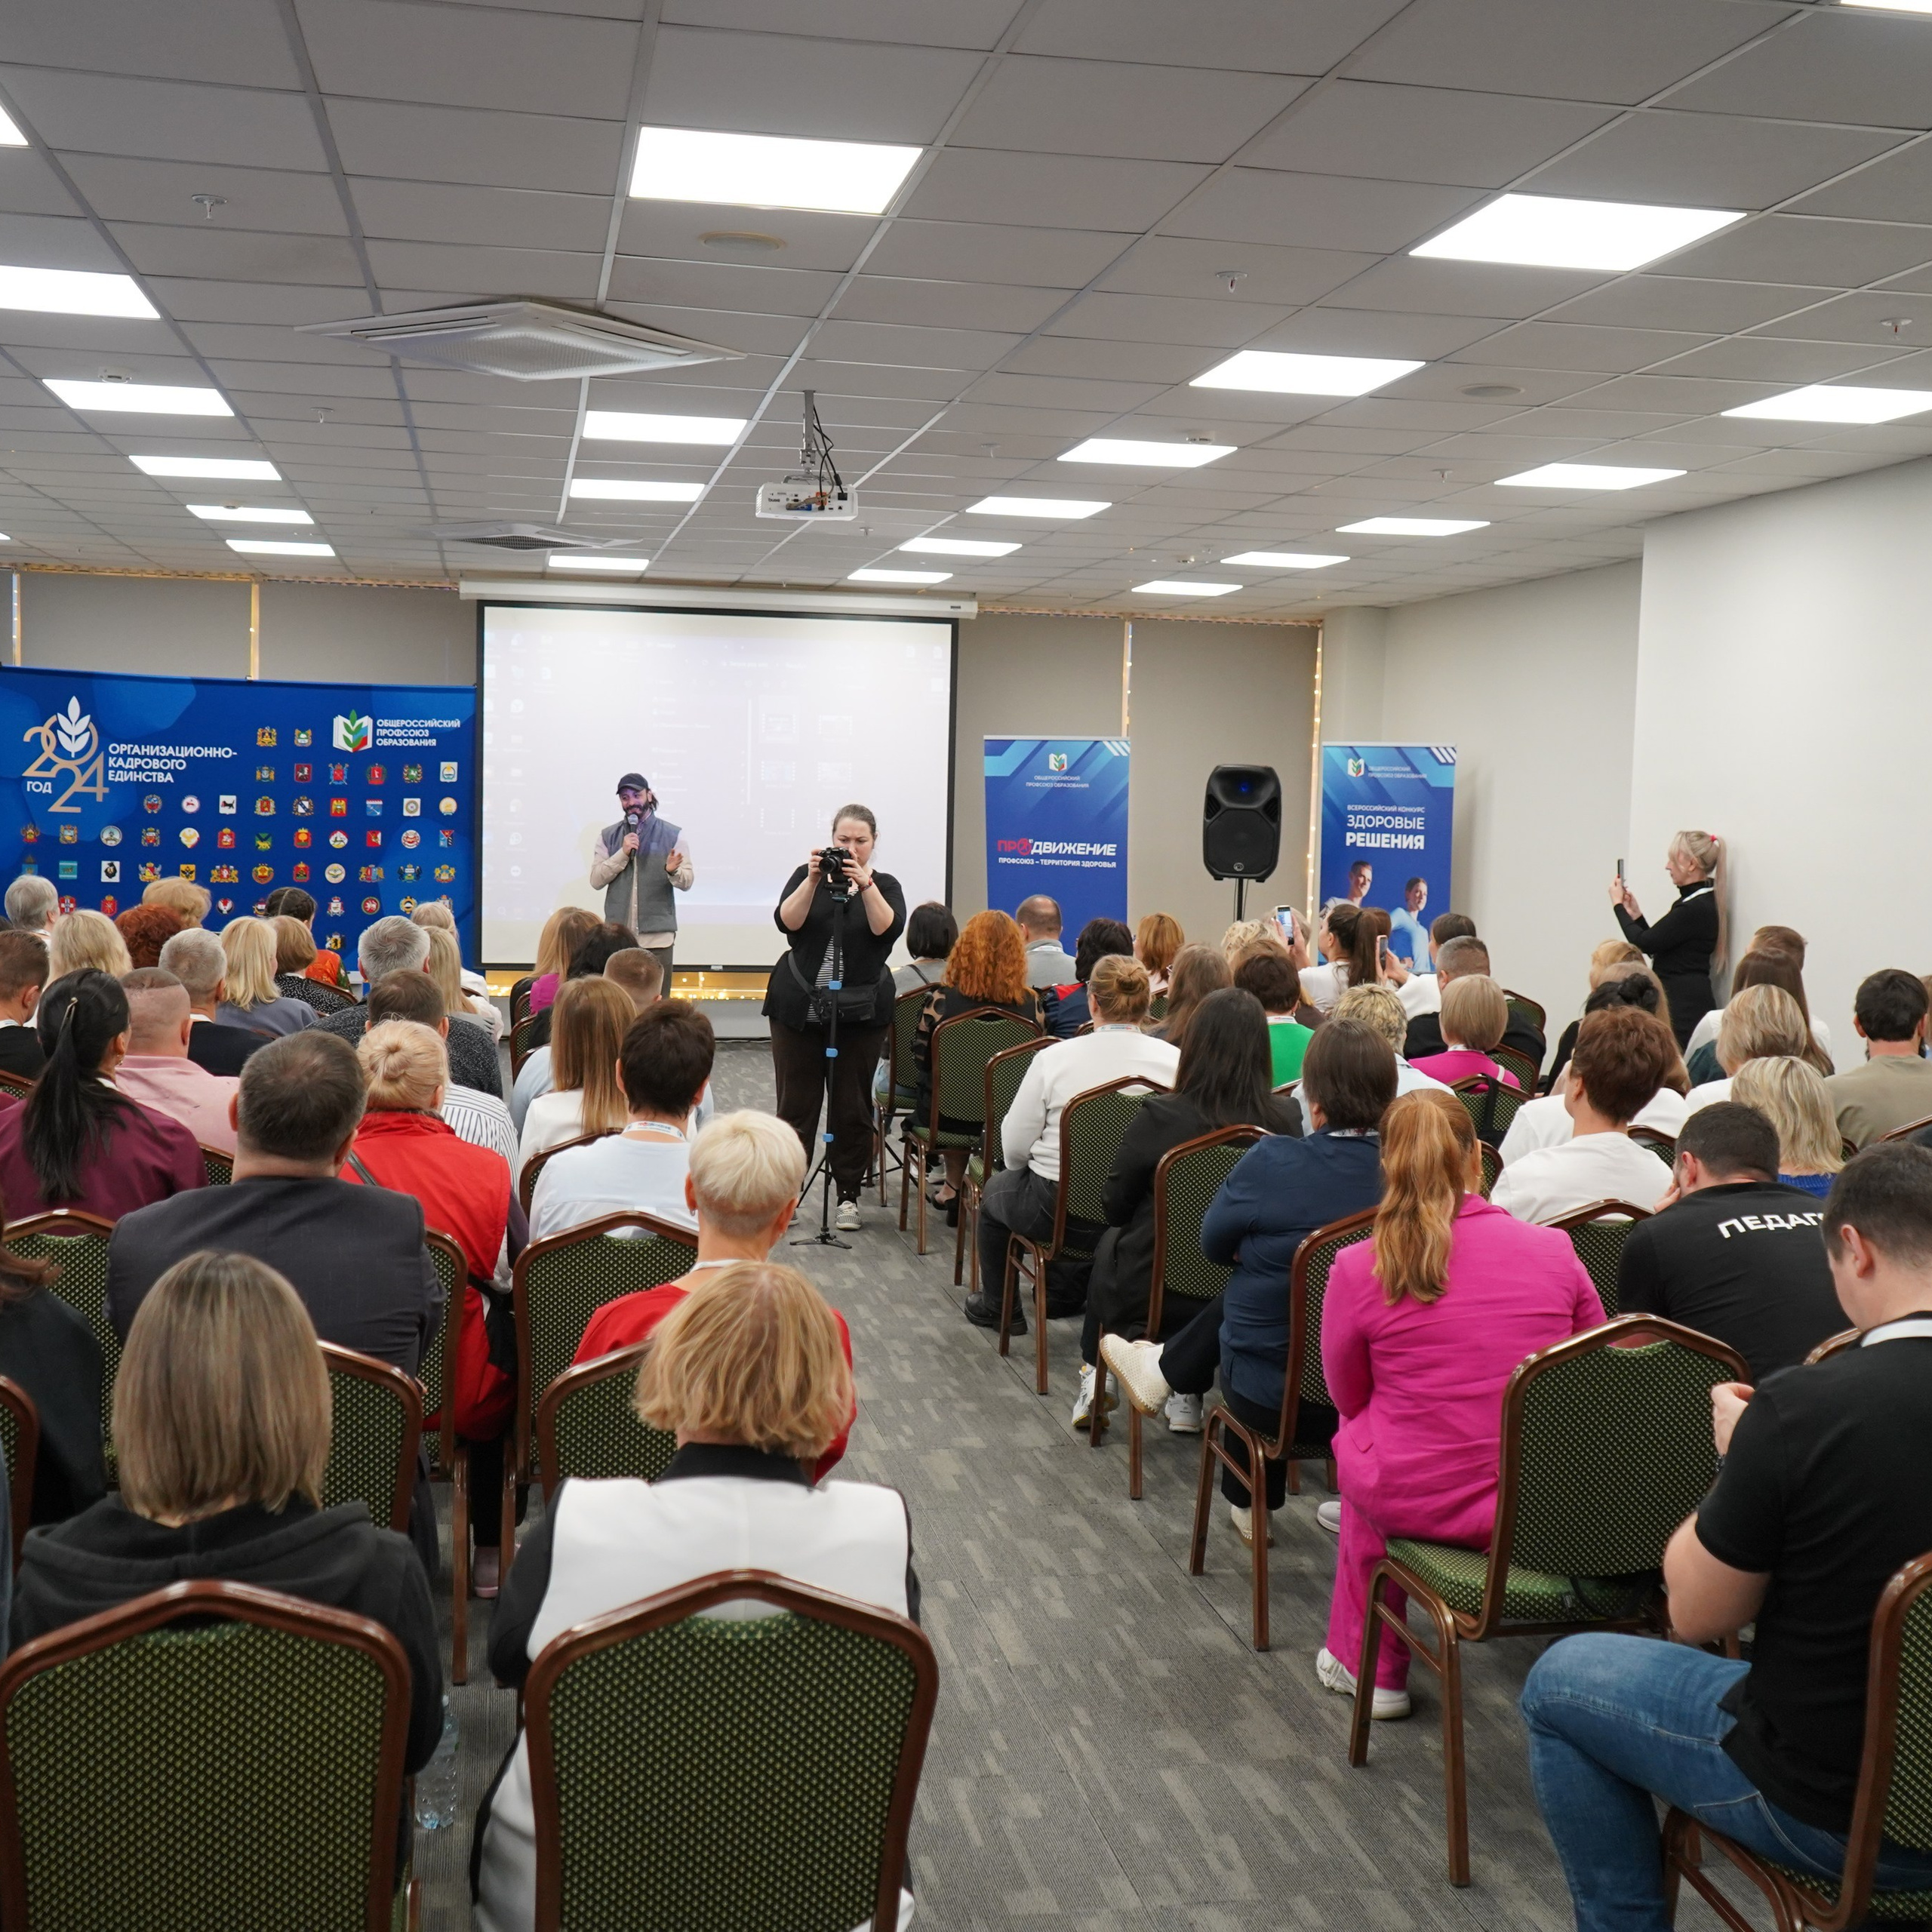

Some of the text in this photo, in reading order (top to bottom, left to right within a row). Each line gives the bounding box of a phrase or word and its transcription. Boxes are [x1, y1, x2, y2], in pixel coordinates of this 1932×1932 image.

[377, 718, 460, 728] ОБЩЕРОССИЙСКИЙ
[376, 738, 437, 746] ОБРАЗОВАНИЯ
[108, 743, 238, 758] ОРГАНИЗАЦИОННО-
[108, 757, 187, 771] КАДРОВОГО
[108, 770, 174, 783] ЕДИНСТВА
[26, 780, 53, 794] ГОД
[1346, 814, 1425, 829] ЗДОРОВЫЕ
[1346, 832, 1425, 850] РЕШЕНИЯ
[998, 857, 1035, 866] ПРОФСОЮЗ
[1717, 1212, 1824, 1238] ПЕДАГ
